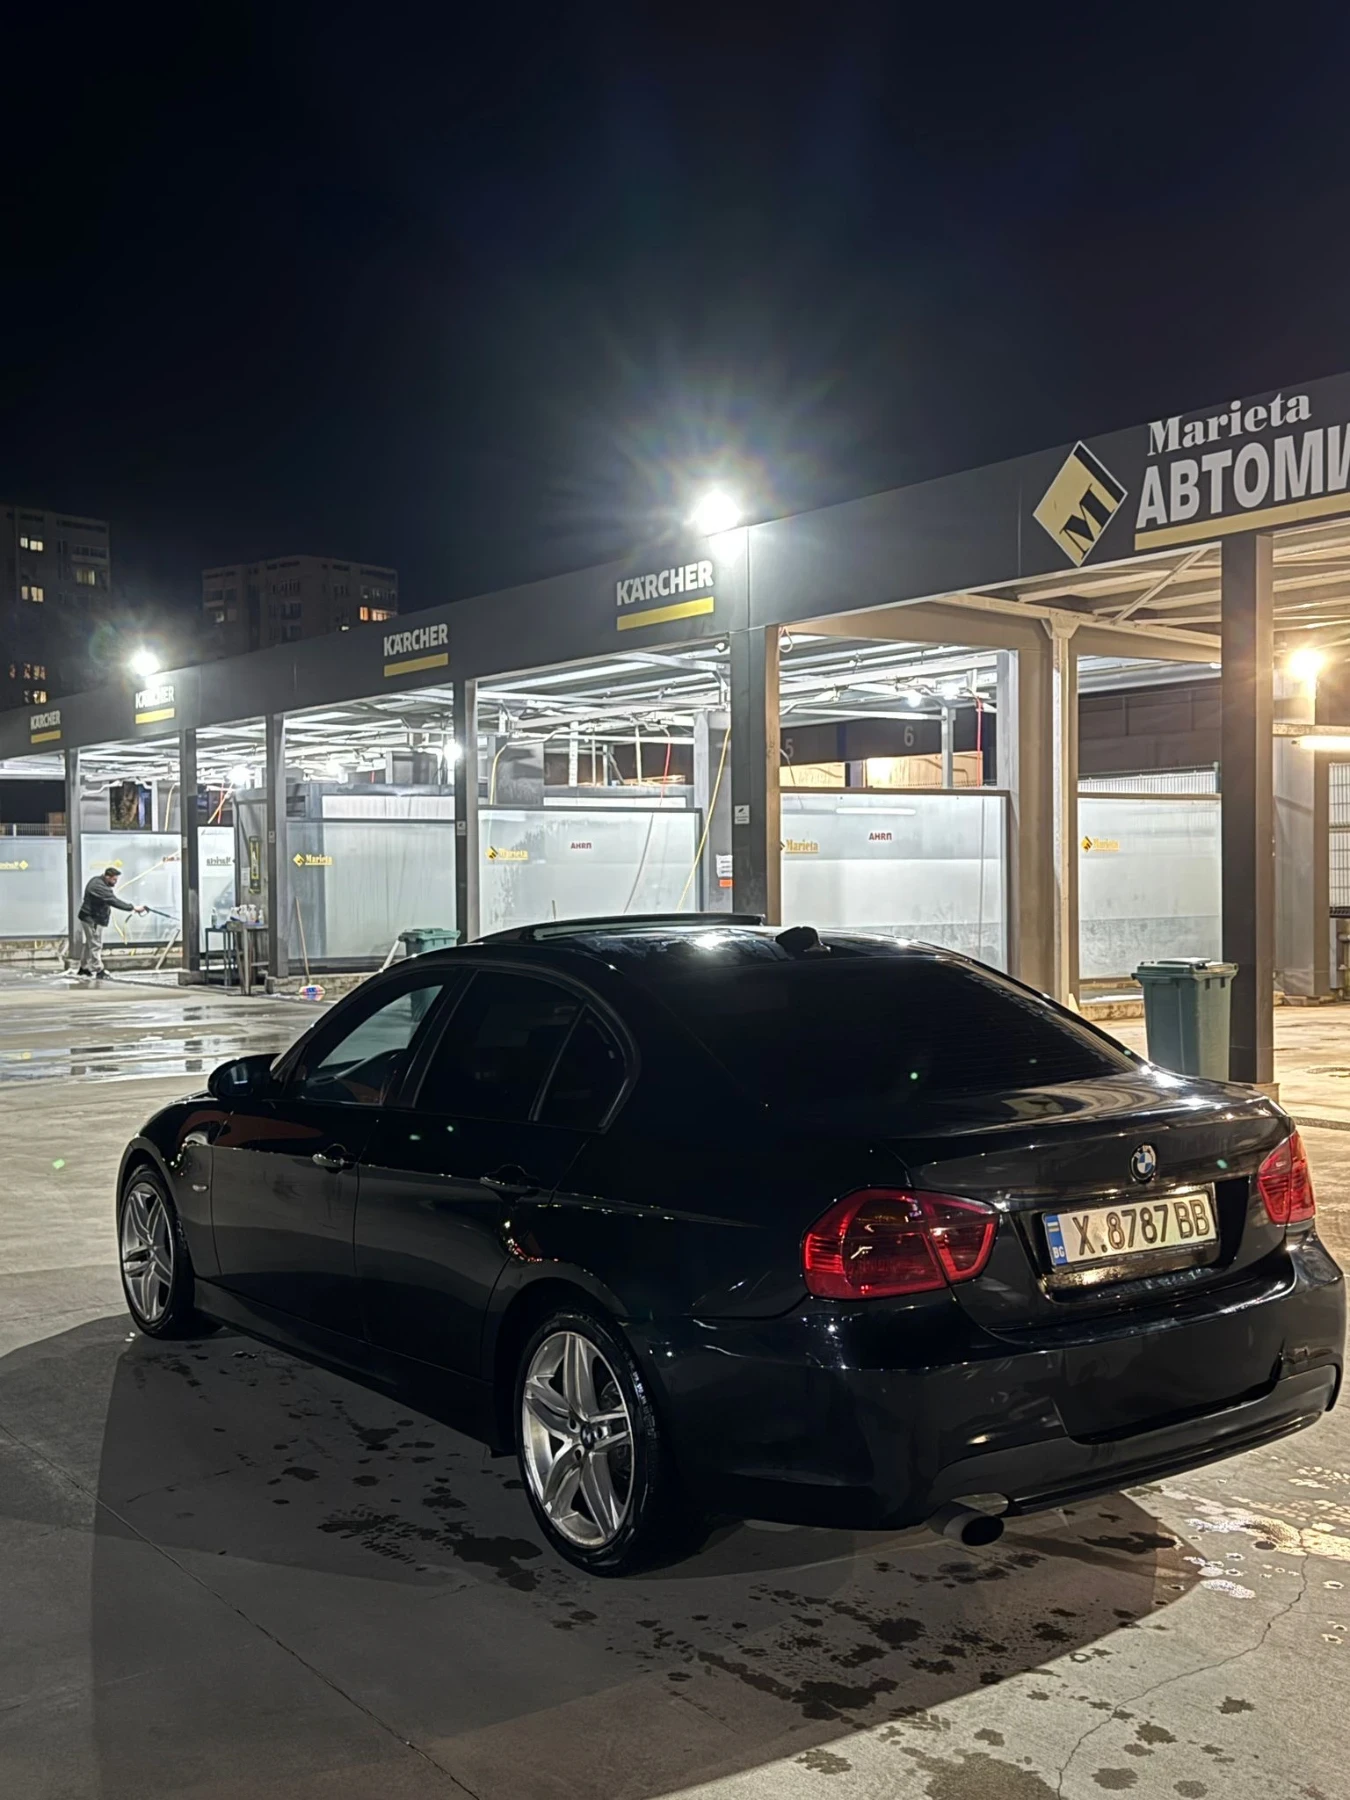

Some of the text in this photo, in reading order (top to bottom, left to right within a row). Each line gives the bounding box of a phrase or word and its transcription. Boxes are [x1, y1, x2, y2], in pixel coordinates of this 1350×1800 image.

[1147, 393, 1312, 457] Marieta
[616, 560, 714, 606] KÄRCHER
[384, 623, 448, 657] KÄRCHER
[784, 738, 794, 758] 5
[904, 726, 914, 747] 6
[1052, 1246, 1065, 1258] BG
